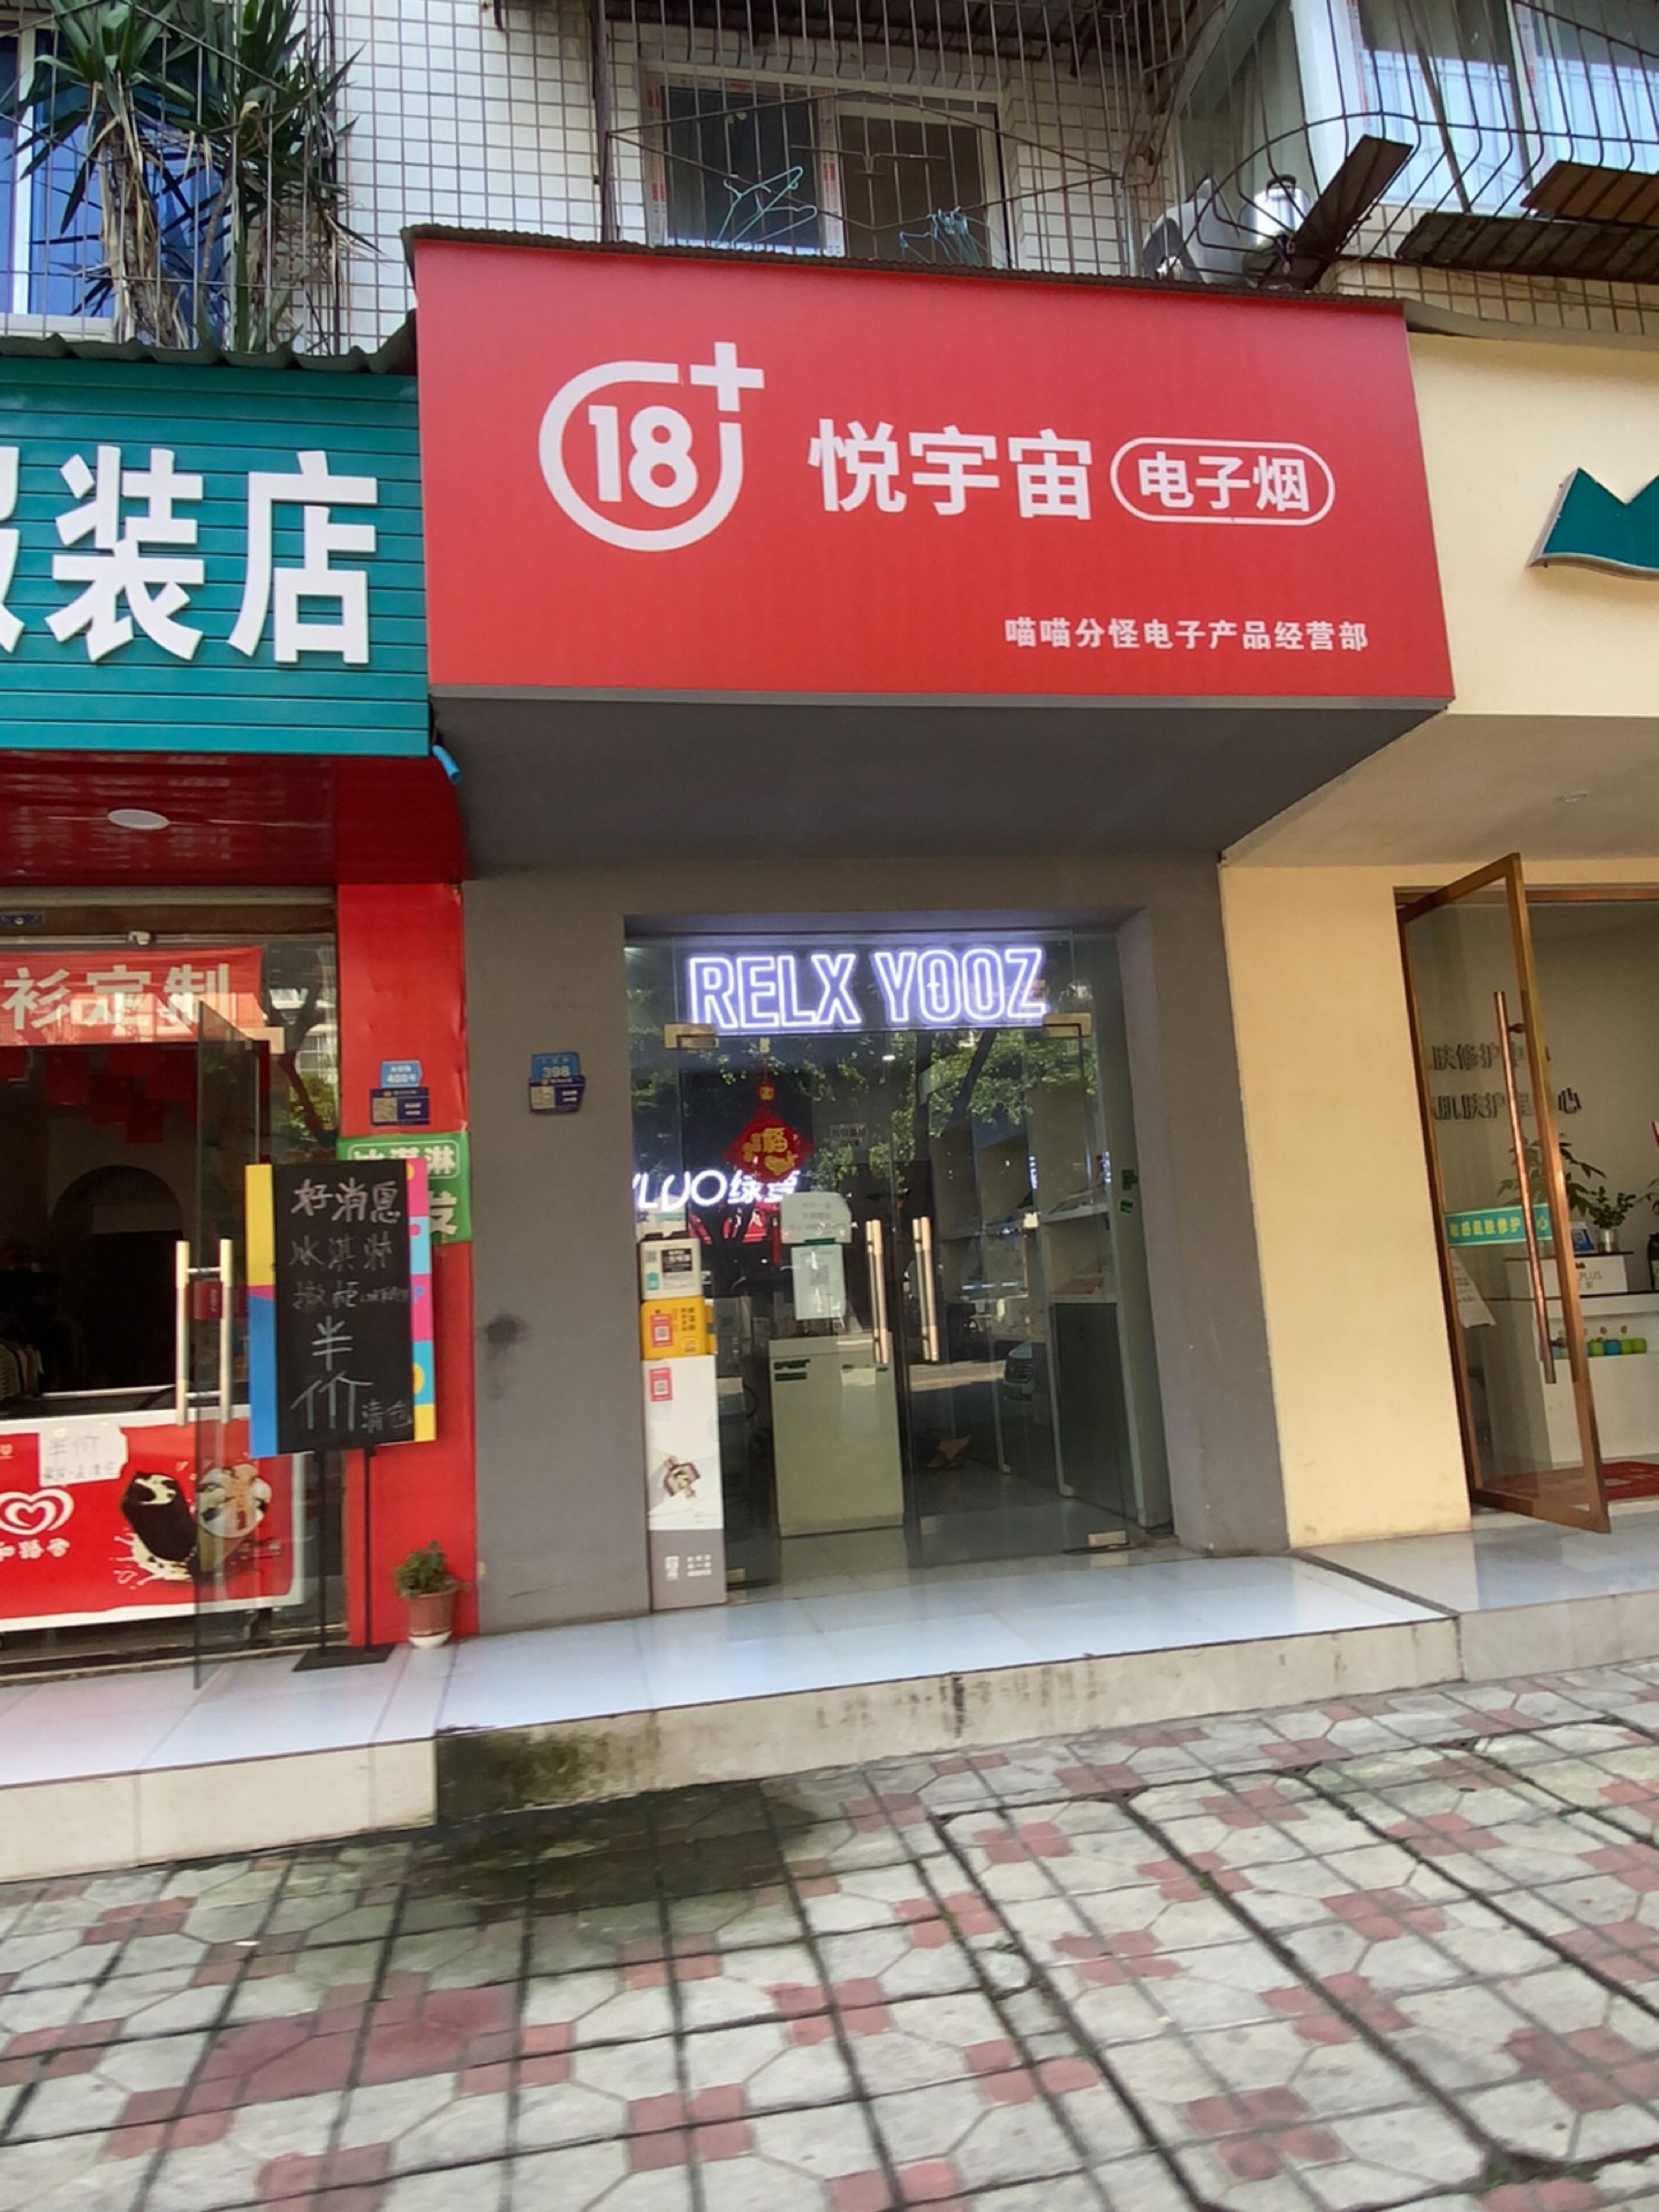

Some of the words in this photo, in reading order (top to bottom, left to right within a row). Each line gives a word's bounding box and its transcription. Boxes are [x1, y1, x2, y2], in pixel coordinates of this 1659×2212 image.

[807, 418, 1093, 520] 悦宇宙
[1137, 451, 1310, 512] 电子烟
[0, 445, 377, 664] 装店
[1004, 616, 1369, 652] 喵喵分怪电子产品经营部
[689, 955, 862, 1032] RELX
[874, 947, 1048, 1024] YOOZ
